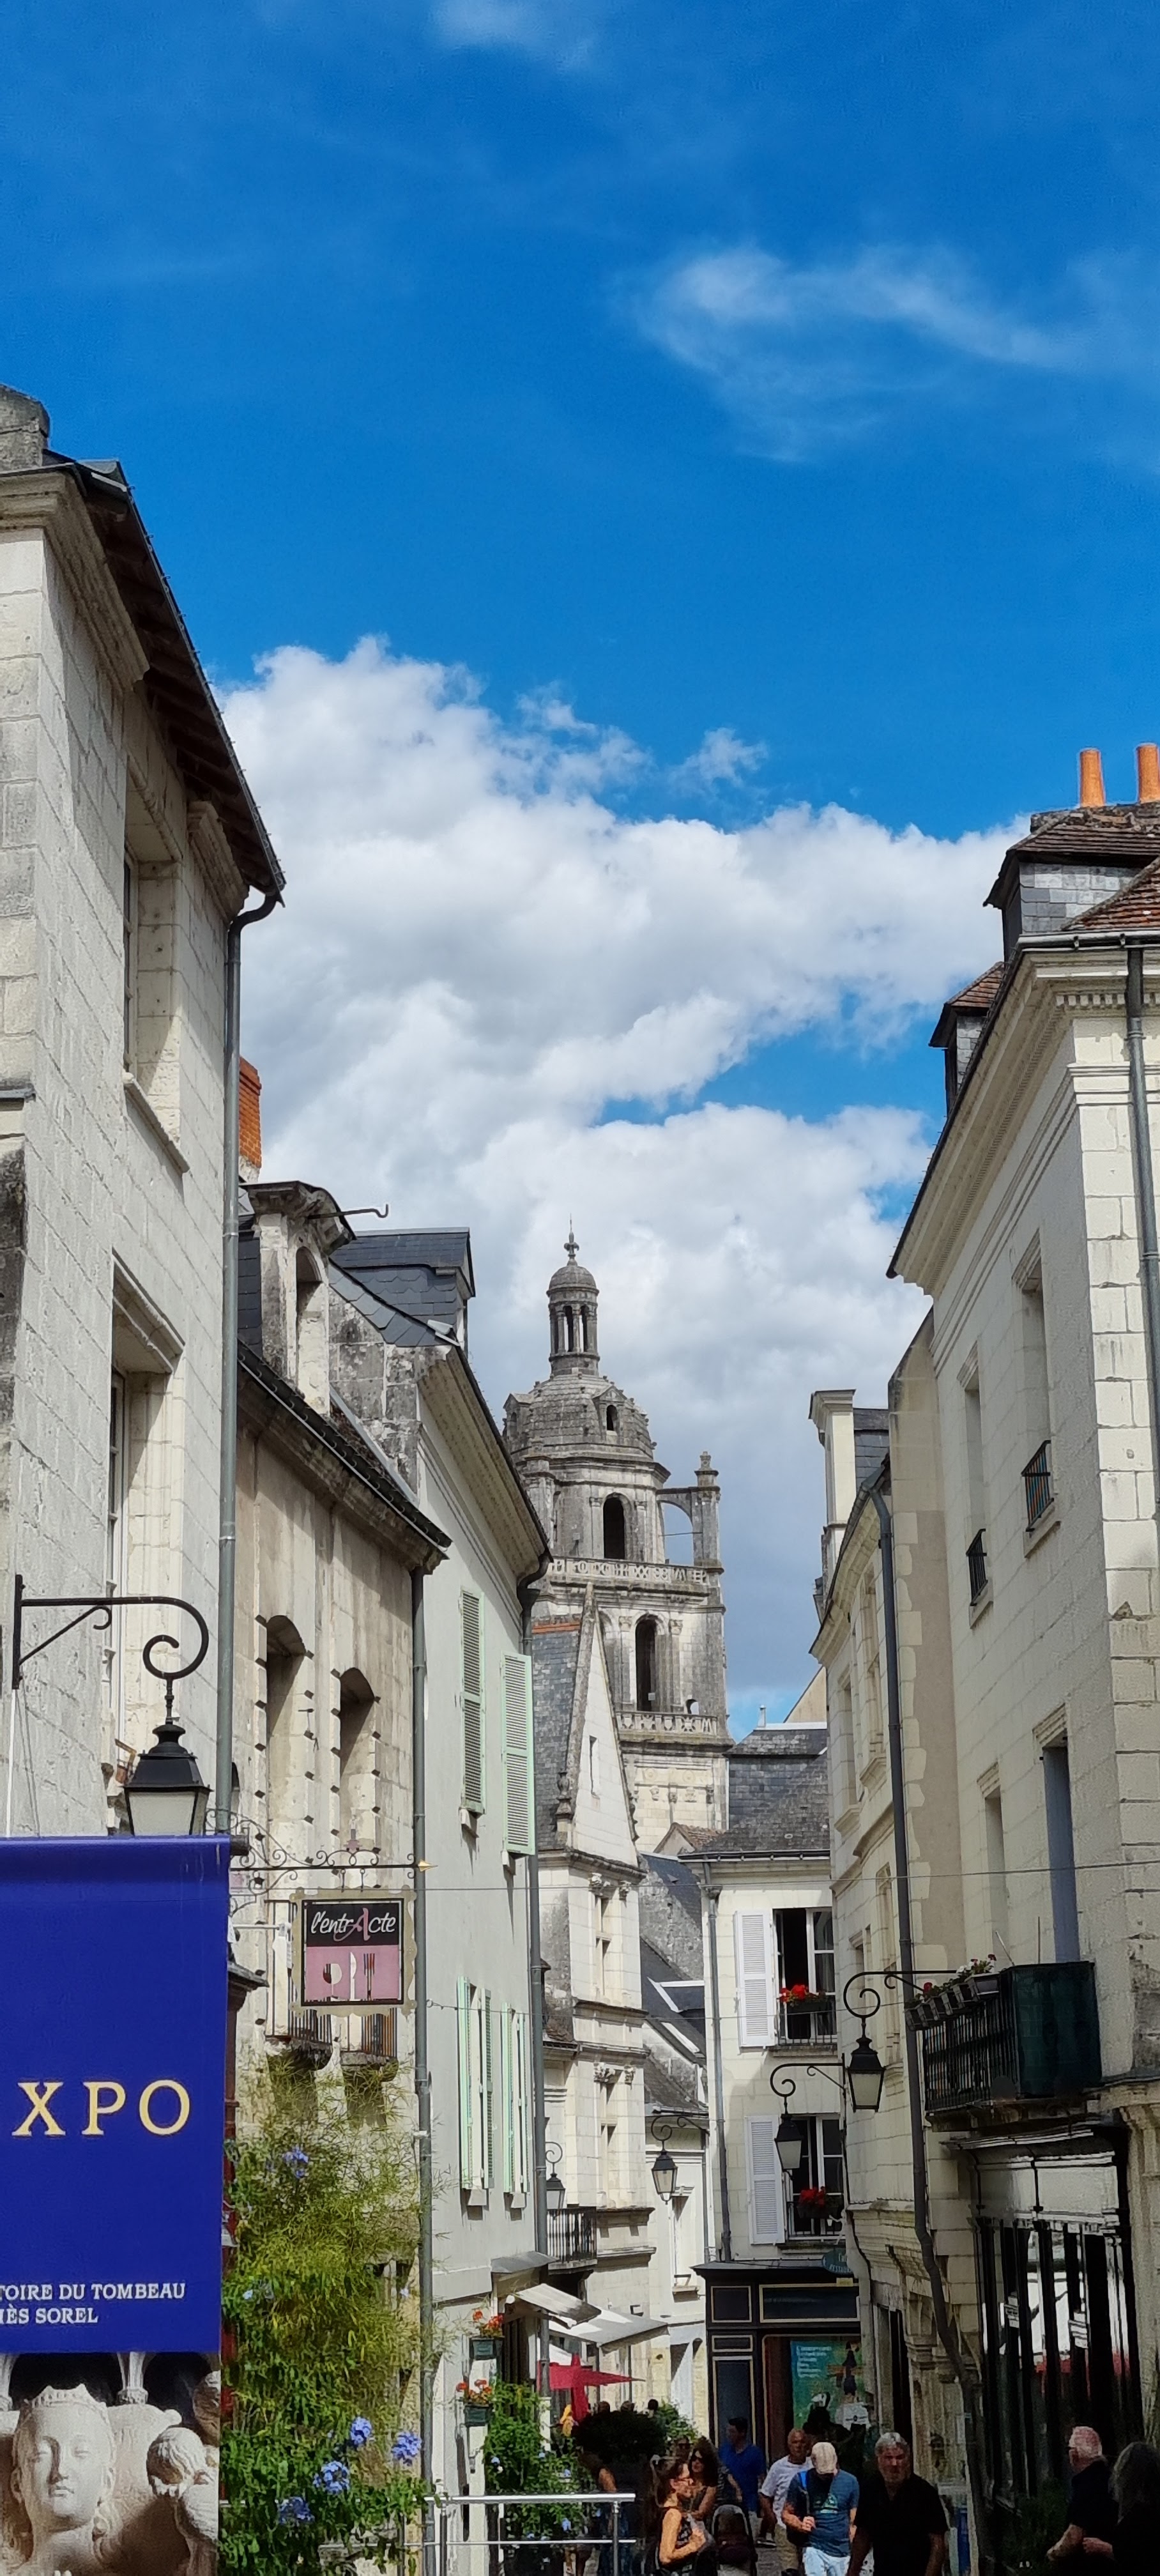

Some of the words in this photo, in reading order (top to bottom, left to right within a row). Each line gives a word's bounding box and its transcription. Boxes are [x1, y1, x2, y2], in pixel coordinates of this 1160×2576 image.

[310, 1907, 397, 1942] l'entrActe
[11, 2079, 190, 2136] XPO
[59, 2283, 86, 2300] DU
[91, 2282, 186, 2300] TOMBEAU
[35, 2307, 98, 2324] SOREL
